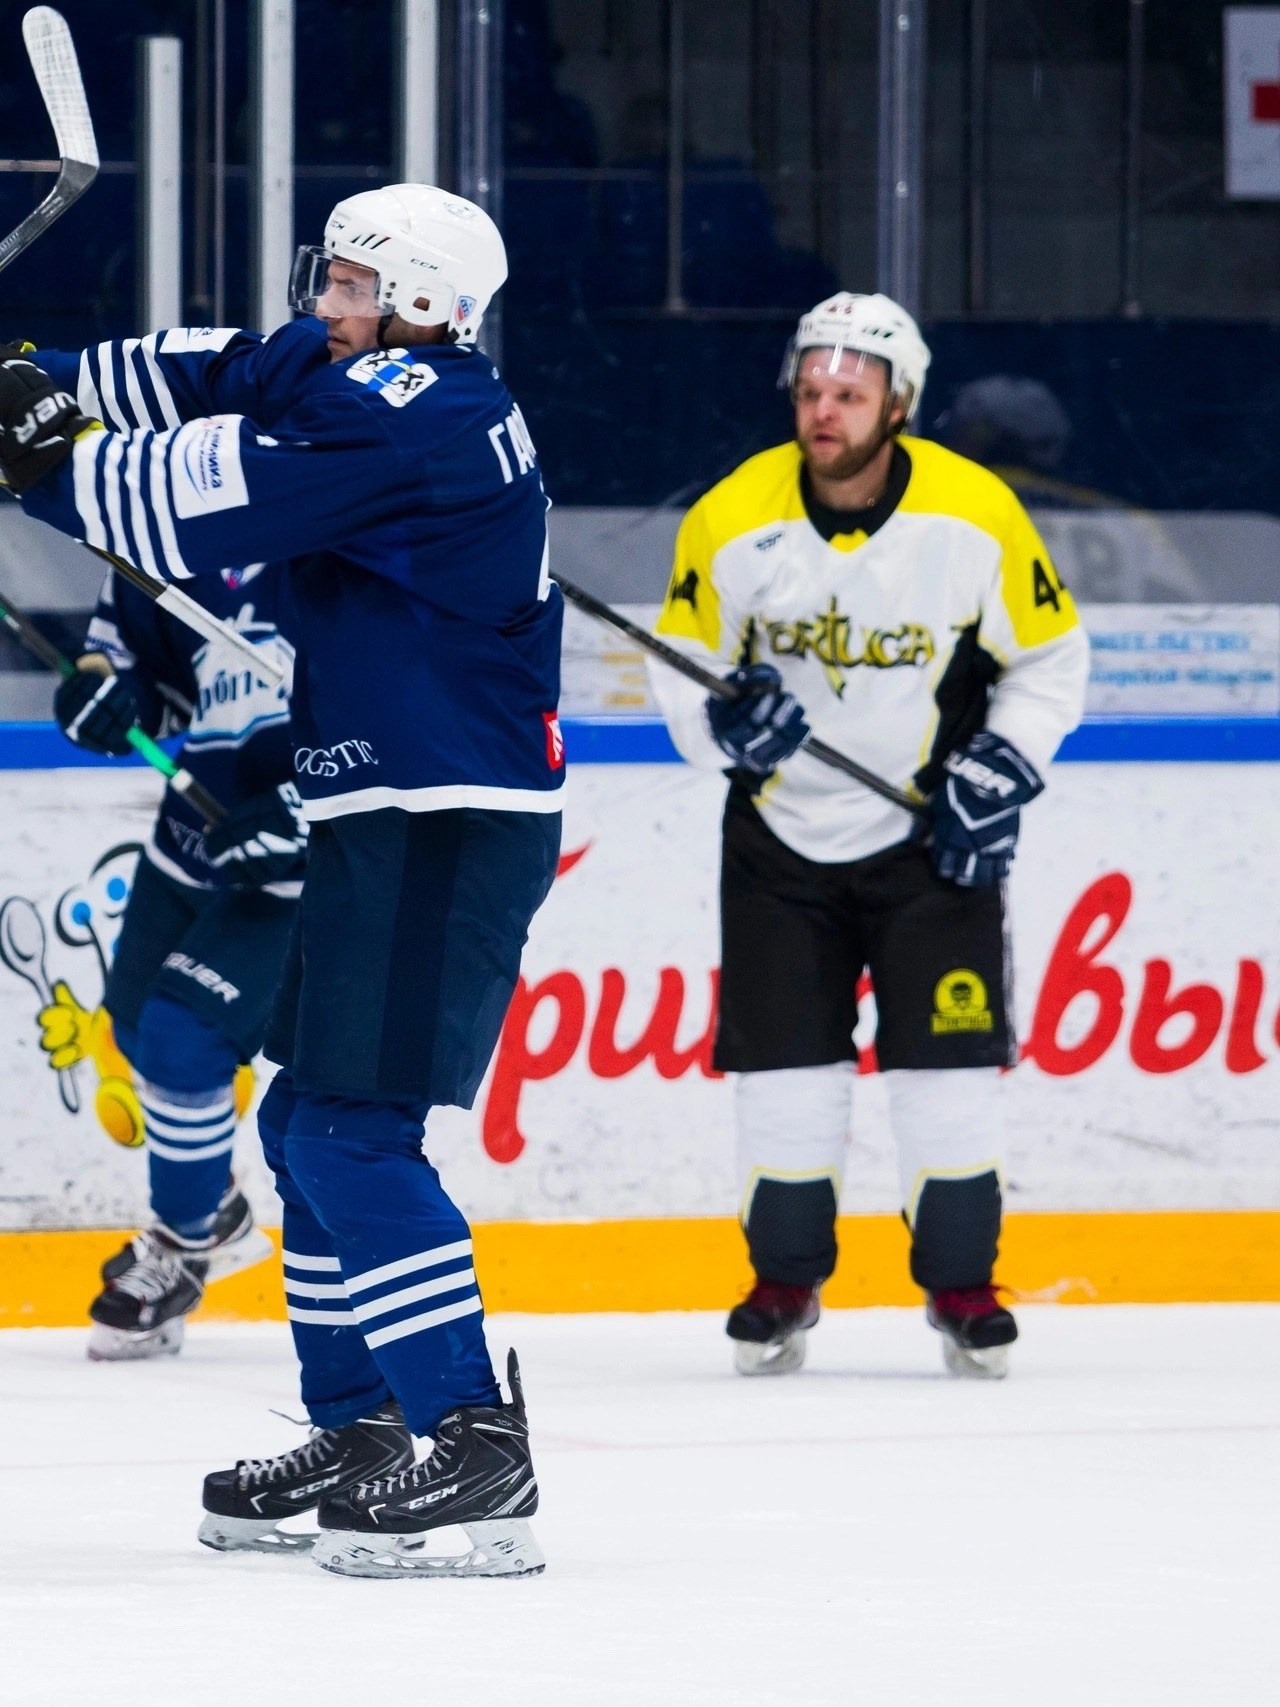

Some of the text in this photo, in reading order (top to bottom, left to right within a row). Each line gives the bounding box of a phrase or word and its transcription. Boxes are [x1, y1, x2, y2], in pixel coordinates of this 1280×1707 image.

[410, 257, 439, 271] CCM
[1033, 559, 1066, 613] 4
[290, 1474, 340, 1500] CCM
[408, 1483, 459, 1510] CCM
